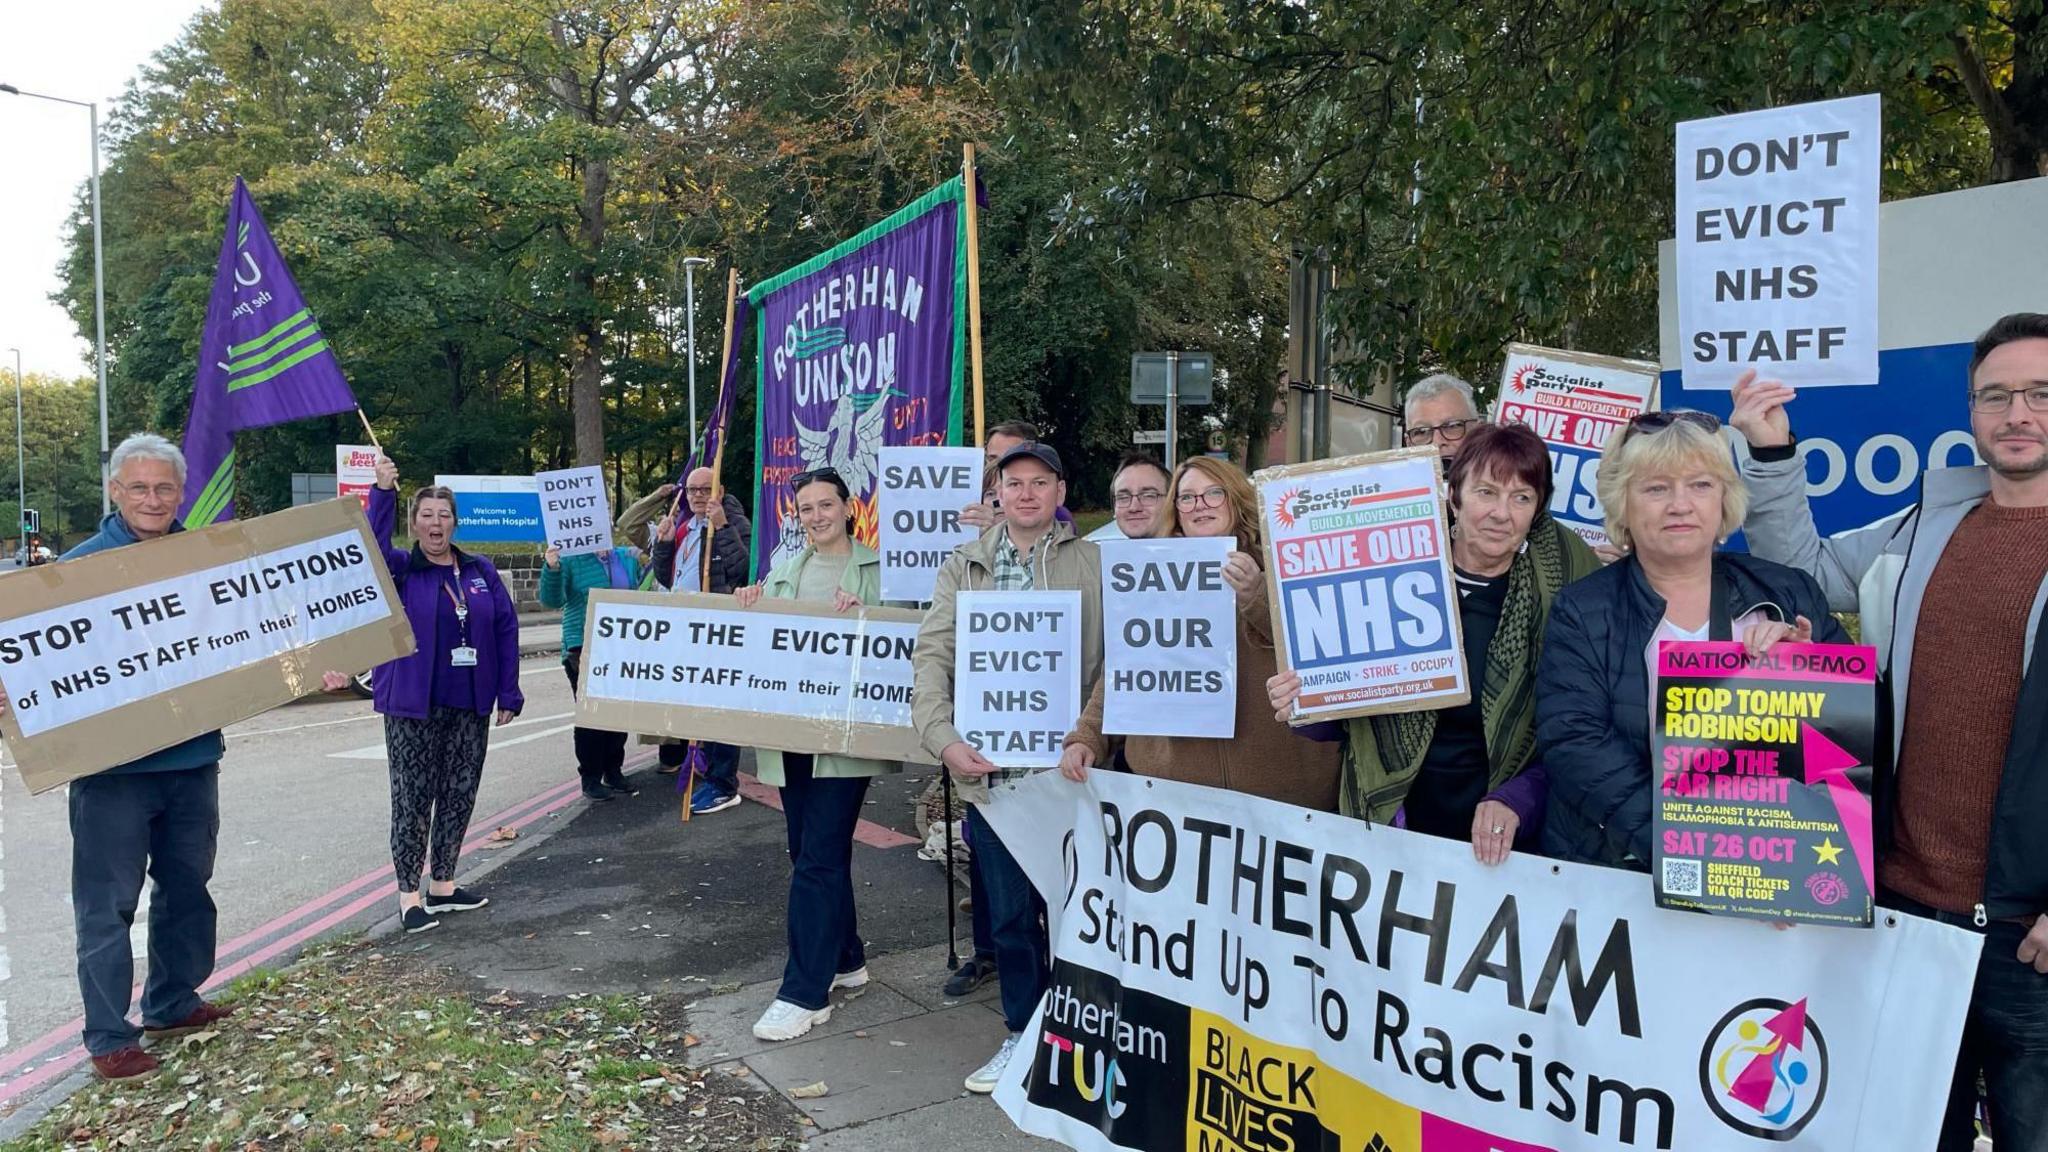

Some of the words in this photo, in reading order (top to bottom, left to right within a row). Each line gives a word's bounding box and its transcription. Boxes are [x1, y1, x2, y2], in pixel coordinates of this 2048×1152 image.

[1696, 131, 1850, 181] DON'T
[1696, 197, 1846, 243] EVICT
[1715, 264, 1818, 302] NHS
[1693, 327, 1846, 363] STAFF
[795, 332, 896, 407] UNISON
[1533, 368, 1604, 389] Socialist
[1537, 392, 1563, 407] BUILD
[1564, 398, 1571, 408] A
[1572, 400, 1624, 417] MOVEMENT
[1625, 408, 1637, 417] TO
[1505, 406, 1568, 440] SAVE
[1574, 418, 1623, 447] OU
[350, 459, 376, 467] Bees
[352, 451, 376, 460] Busy
[544, 476, 594, 492] DON'T
[884, 466, 971, 490] SAVE
[1551, 452, 1604, 520] HS
[547, 496, 597, 512] EVICT
[1297, 482, 1382, 505] Socialist
[457, 517, 500, 526] otherham
[502, 517, 539, 527] Hospital
[473, 507, 506, 515] Welcome
[558, 516, 593, 530] NHS
[893, 509, 962, 534] OUR
[1311, 513, 1344, 531] BUILD
[1345, 513, 1355, 526] A
[1355, 504, 1414, 524] MOVEMENT
[1414, 502, 1432, 515] TO
[553, 533, 603, 550] STAFF
[1281, 534, 1360, 575] SAVE
[1367, 524, 1434, 563] OUR
[886, 550, 953, 568] HOM
[1110, 560, 1223, 593] SAVE
[1, 617, 92, 664] STOP
[112, 593, 186, 630] THE
[209, 544, 364, 605] EVICTIONS
[1290, 570, 1443, 662] NHS
[968, 611, 1064, 634] DON'T
[1122, 617, 1213, 649] OUR
[18, 689, 39, 711] of
[50, 665, 111, 699] NHS
[118, 636, 200, 678] STAFF
[207, 628, 250, 651] from
[259, 613, 298, 634] their
[306, 585, 378, 620] HOMES
[598, 616, 671, 641] STOP
[688, 622, 745, 647] THE
[771, 628, 914, 660] EVICTION
[968, 650, 1063, 673] EVICT
[1362, 663, 1400, 680] STRIKE
[1411, 656, 1454, 673] OCCUPY
[1668, 652, 1786, 671] NATIONAL
[1792, 654, 1866, 674] DEMO
[593, 664, 609, 677] of
[620, 662, 665, 681] NHS
[671, 665, 743, 687] STAFF
[748, 674, 787, 692] from
[798, 680, 841, 696] their
[854, 683, 914, 704] HOM
[1113, 670, 1223, 694] HOMES
[1323, 680, 1434, 703] www.socialistparty.org.uk
[982, 690, 1048, 713] NHS
[1666, 687, 1731, 713] STOP
[1737, 689, 1825, 718] TOMMY
[965, 730, 1065, 753] STAFF
[1665, 713, 1797, 743] ROBINSON
[1663, 746, 1729, 773] STOP
[1734, 749, 1780, 776] THE
[1662, 772, 1710, 799] FAR
[1714, 776, 1791, 804] RIGHT
[1663, 802, 1693, 813] UNITE
[1695, 805, 1744, 816] AGAINST
[1747, 808, 1793, 820] RACISM,
[1663, 812, 1745, 827] ISLAMOPHOBIA
[1748, 818, 1755, 827] &
[1758, 819, 1839, 832] ANTISEMITISM
[1663, 830, 1707, 856] SAT
[1712, 833, 1743, 858] 26
[1749, 836, 1796, 863] OCT
[1707, 862, 1761, 877] SHEFFIELD
[1707, 874, 1744, 887] COACH
[1746, 877, 1790, 891] TICKETS
[1707, 885, 1726, 897] VIA
[1728, 887, 1744, 899] QR
[1745, 888, 1775, 900] CODE
[1100, 800, 1642, 1038] ROTHERHAM
[1044, 985, 1166, 1064] otheram
[1220, 930, 1269, 1022] Up
[1294, 955, 1348, 1041] To
[1373, 989, 1675, 1150] Racism
[1043, 1031, 1127, 1119] TUC
[1206, 1027, 1318, 1109] BLACK
[1200, 1077, 1296, 1152] LIVES
